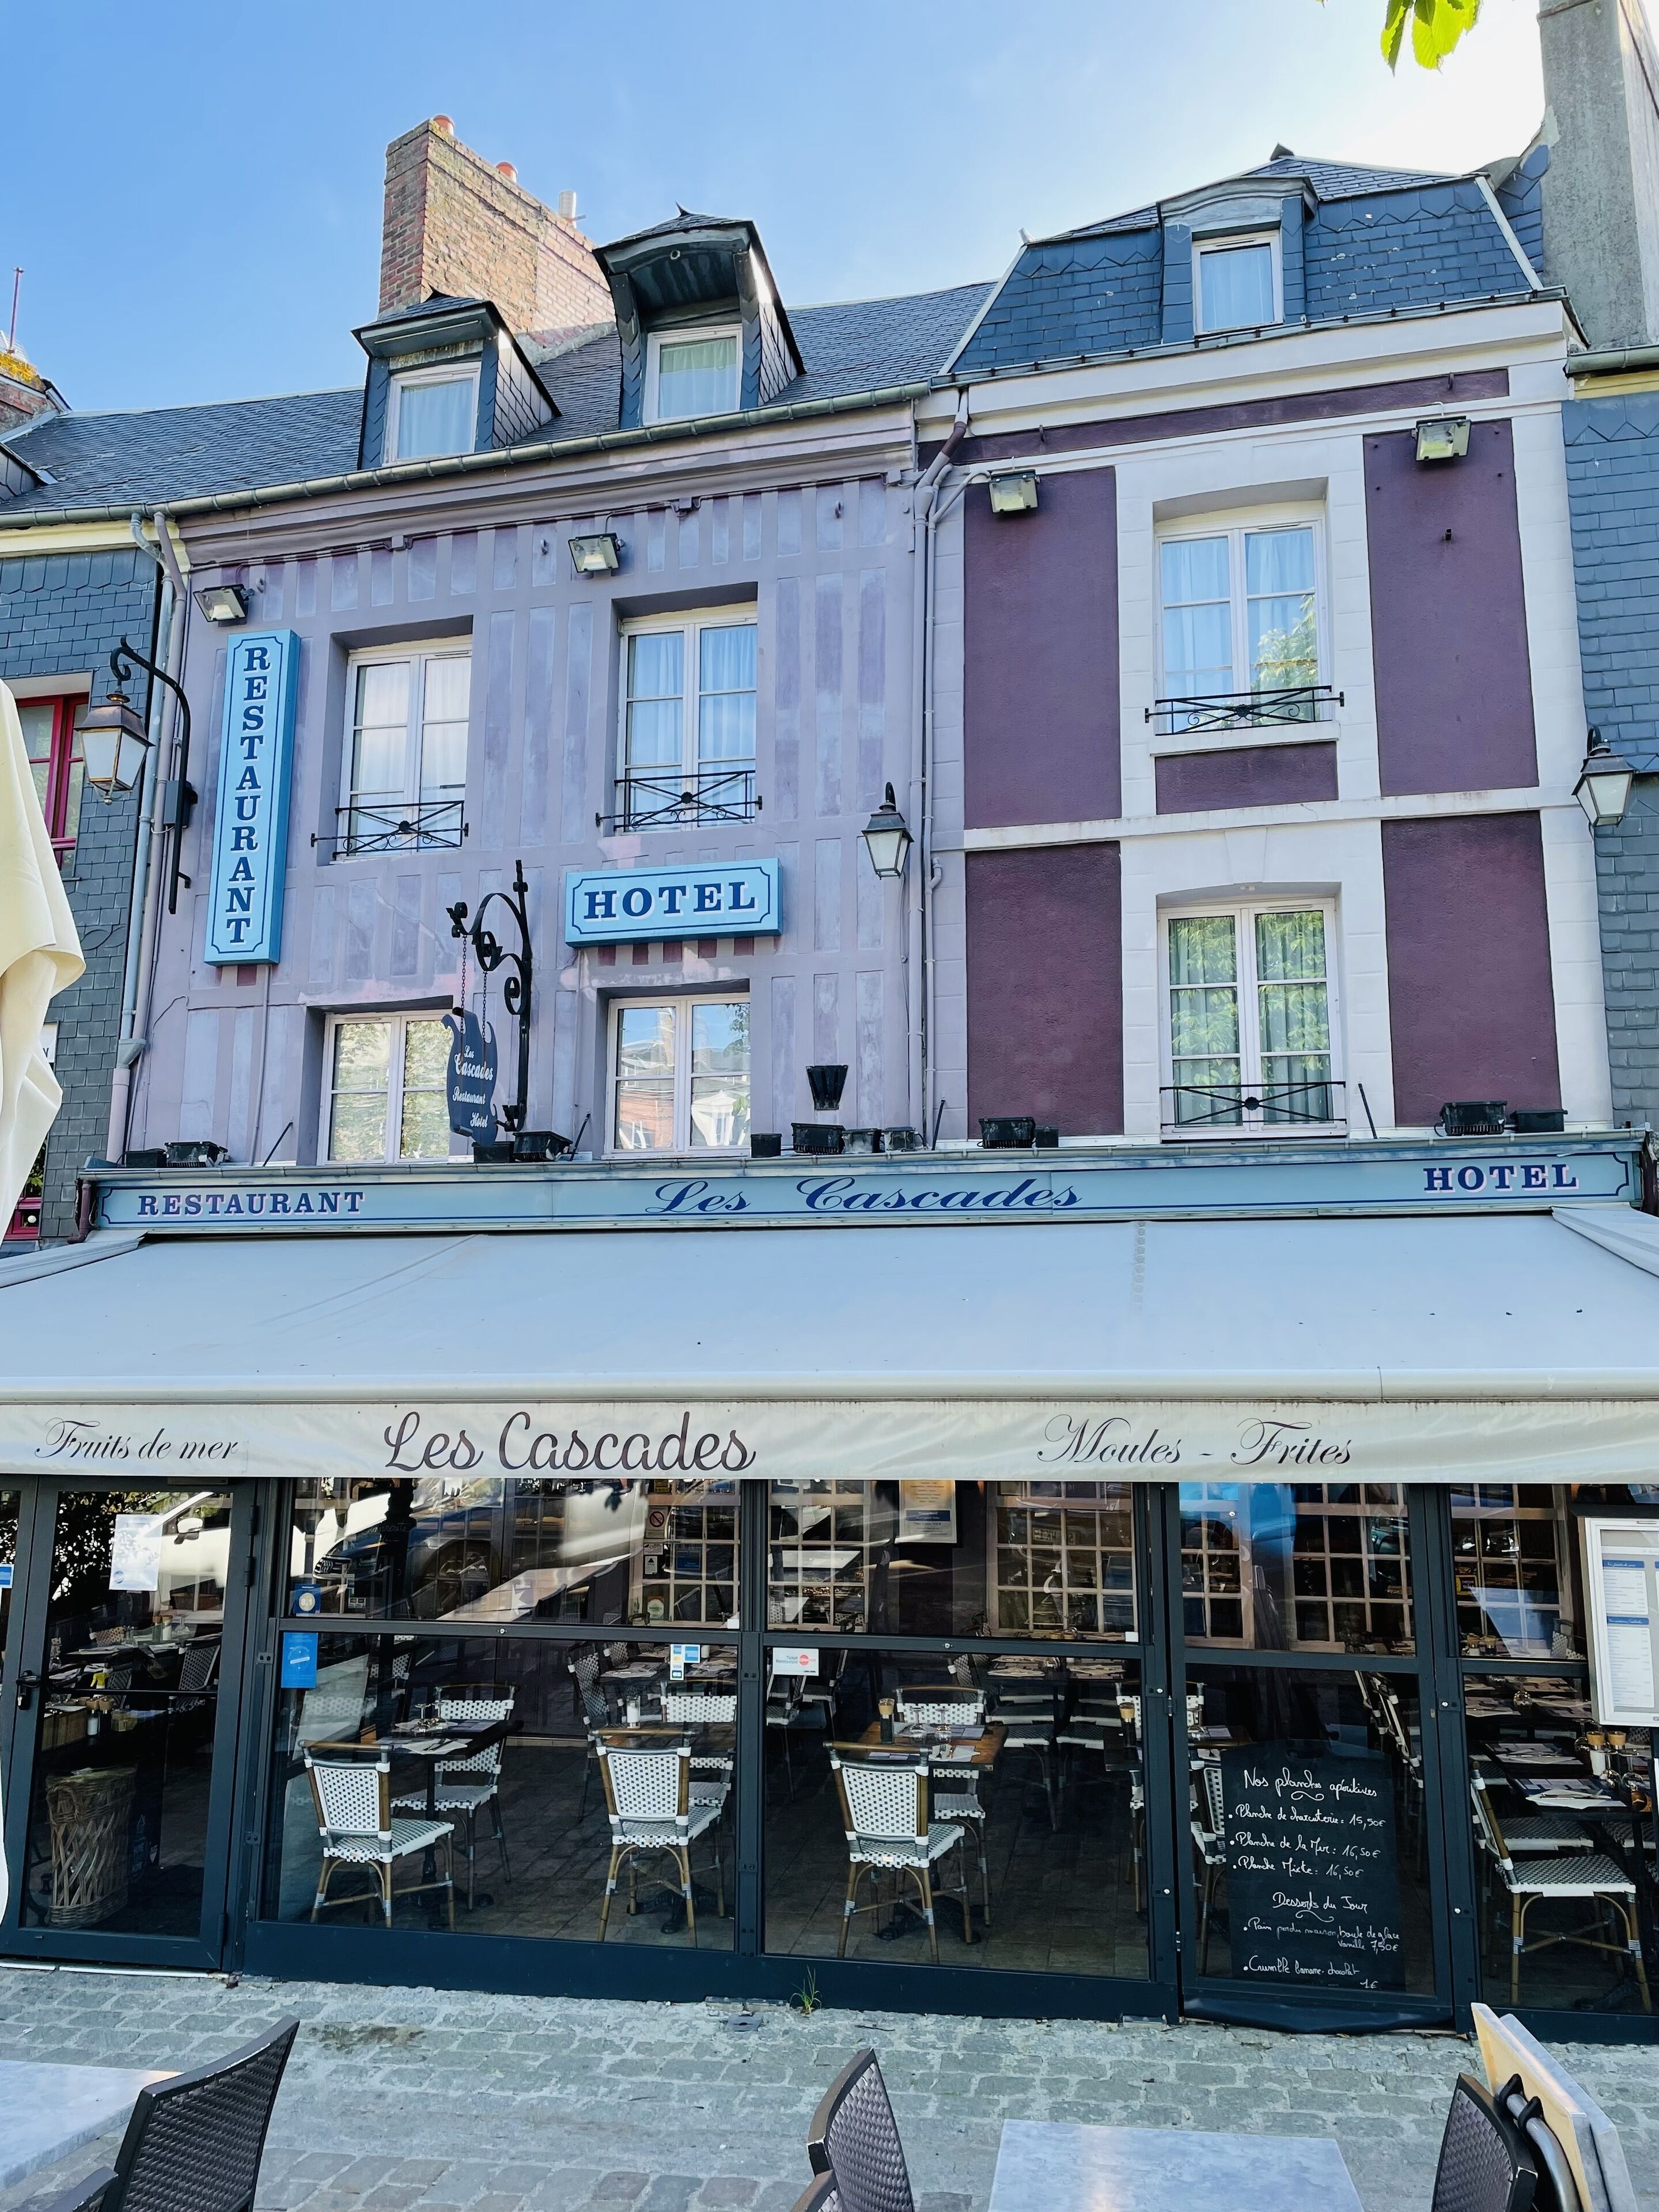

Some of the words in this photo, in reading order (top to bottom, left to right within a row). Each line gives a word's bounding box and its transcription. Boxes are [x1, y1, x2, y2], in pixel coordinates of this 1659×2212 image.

[225, 646, 271, 945] RESTAURANT
[583, 881, 758, 921] HOTEL
[464, 1045, 475, 1058] Les
[454, 1053, 494, 1081] Cascades
[452, 1086, 486, 1105] Restaurant
[1423, 1164, 1580, 1194] HOTEL
[137, 1191, 364, 1217] RESTAURANT
[645, 1179, 751, 1214] Les
[796, 1177, 1083, 1210] Cascades
[34, 1417, 130, 1459] Fruits
[138, 1428, 172, 1459] de
[179, 1441, 238, 1459] mer
[384, 1411, 484, 1472] Les
[499, 1411, 756, 1471] Cascades
[1037, 1414, 1182, 1464] Moules
[1230, 1418, 1352, 1465] Frites
[1244, 1767, 1268, 1789] Nos
[1275, 1767, 1321, 1797] planches
[1236, 1804, 1272, 1819] Planche
[1278, 1807, 1287, 1820] de
[1349, 1814, 1386, 1831] 15,50€
[1236, 1832, 1275, 1847] Planche
[1280, 1836, 1291, 1849] de
[1296, 1834, 1308, 1851] la
[1342, 1844, 1381, 1860] 16,50€
[1238, 1856, 1275, 1870] Planche
[1326, 1864, 1363, 1880] 16,50€
[1272, 1891, 1319, 1910] Desserts
[1323, 1896, 1336, 1910] du
[1340, 1896, 1368, 1914] Jour
[1248, 1917, 1271, 1930] Pain
[1277, 1923, 1301, 1940] perdu
[1339, 1926, 1363, 1938] boule
[1367, 1926, 1376, 1938] de
[1378, 1927, 1400, 1944] glace
[1249, 1955, 1290, 1973] Crumble
